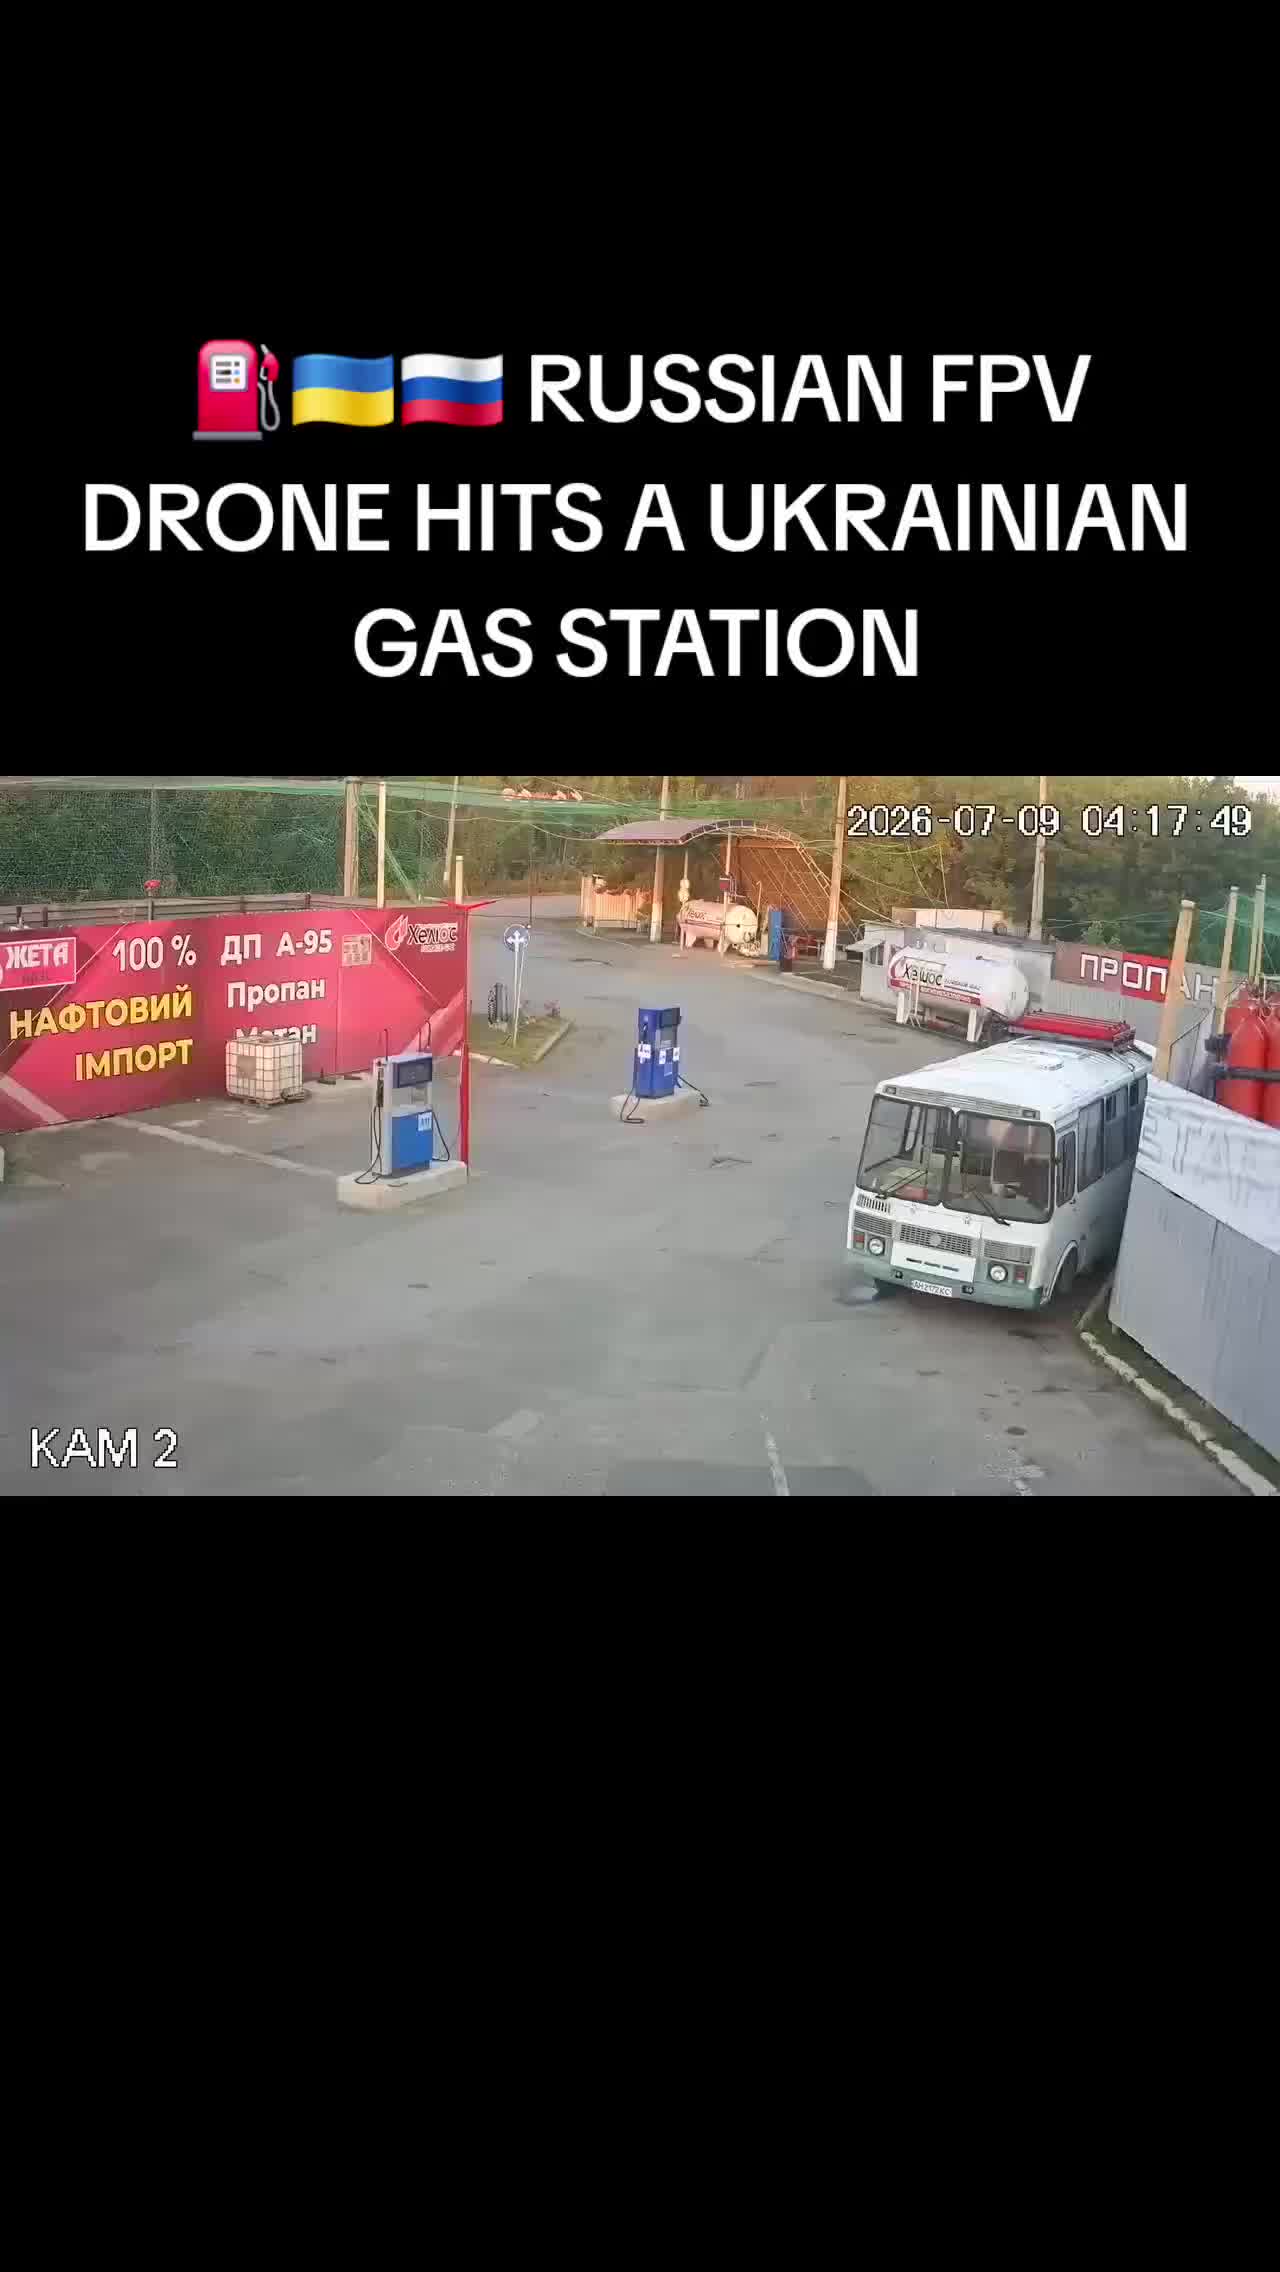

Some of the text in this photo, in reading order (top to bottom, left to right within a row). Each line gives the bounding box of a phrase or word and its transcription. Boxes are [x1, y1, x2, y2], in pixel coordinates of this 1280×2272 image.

[112, 934, 197, 972] 100 %
[220, 933, 262, 967] ДП
[275, 929, 333, 957] А-95
[9, 983, 193, 1040] НАФТОВИЙ
[227, 979, 326, 1013] Пропан
[75, 1038, 193, 1081] ІМПОРТ
